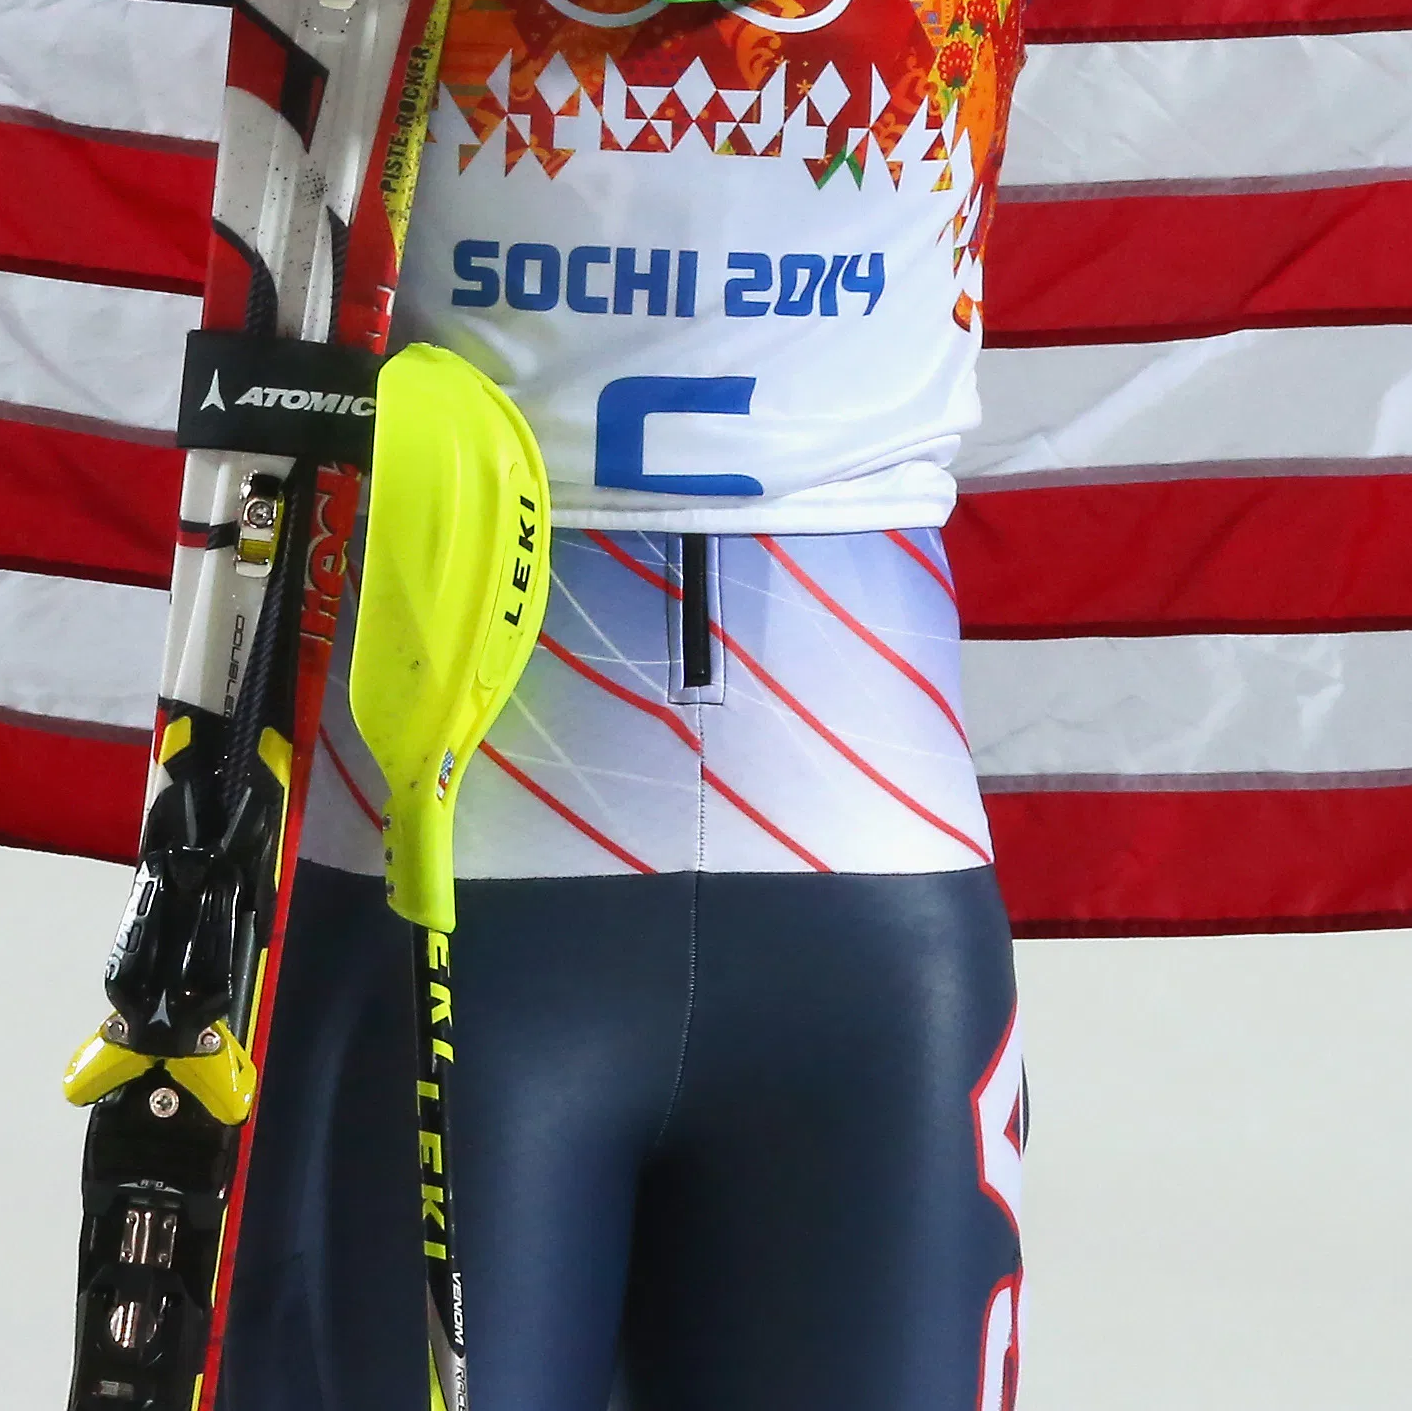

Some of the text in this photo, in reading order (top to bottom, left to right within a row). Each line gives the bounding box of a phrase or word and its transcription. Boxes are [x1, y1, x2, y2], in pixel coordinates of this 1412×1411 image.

[452, 239, 698, 318] SOCHI
[724, 252, 885, 317] 2014
[234, 386, 377, 417] ATOMIC
[503, 495, 536, 627] LEKI
[416, 928, 455, 1261] EKI LEKI
[451, 1272, 465, 1347] VENOM
